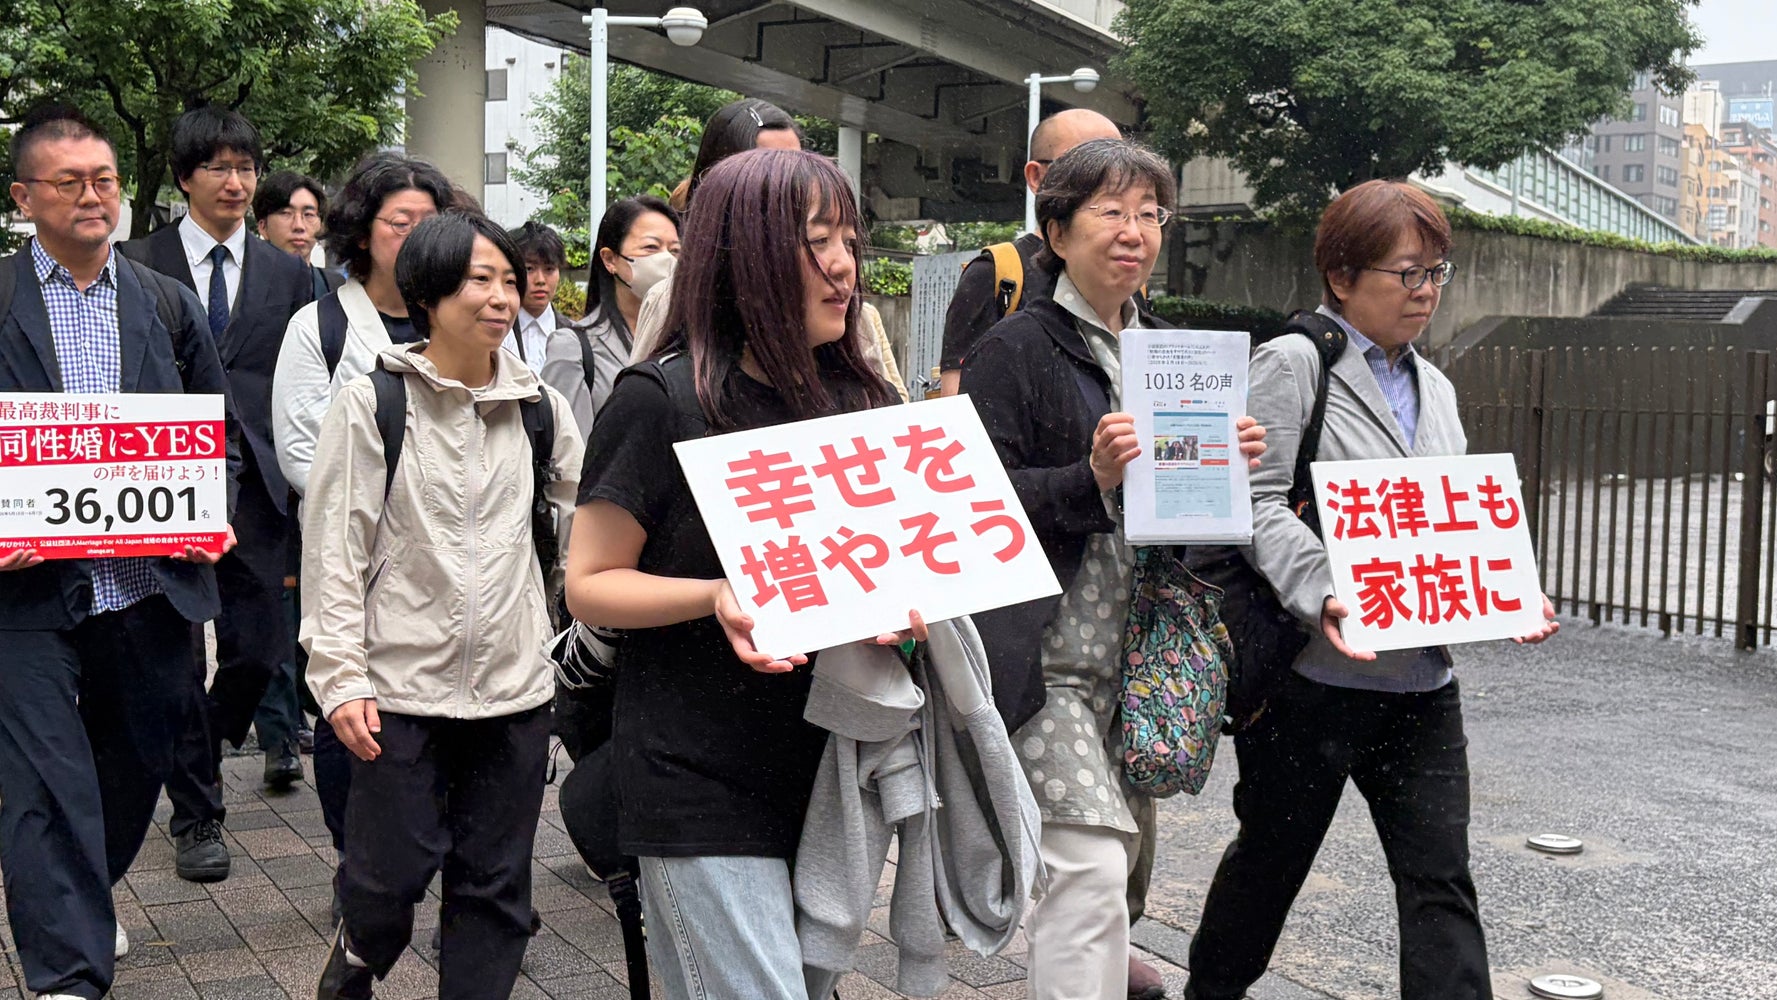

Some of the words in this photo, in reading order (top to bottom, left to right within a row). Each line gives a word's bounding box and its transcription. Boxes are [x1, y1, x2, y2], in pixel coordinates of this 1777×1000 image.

[1145, 373, 1185, 390] 1013
[1190, 372, 1233, 391] 名の声
[0, 401, 121, 421] 最高裁判事に
[0, 424, 217, 463] 同性婚にYES
[725, 425, 976, 529] 幸せを
[1, 498, 36, 509] 賛同者
[45, 486, 196, 532] 36,001
[201, 509, 211, 519] 名
[1326, 475, 1521, 541] 法律上も
[740, 499, 1026, 613] 増やそう
[1351, 553, 1522, 630] 家族に
